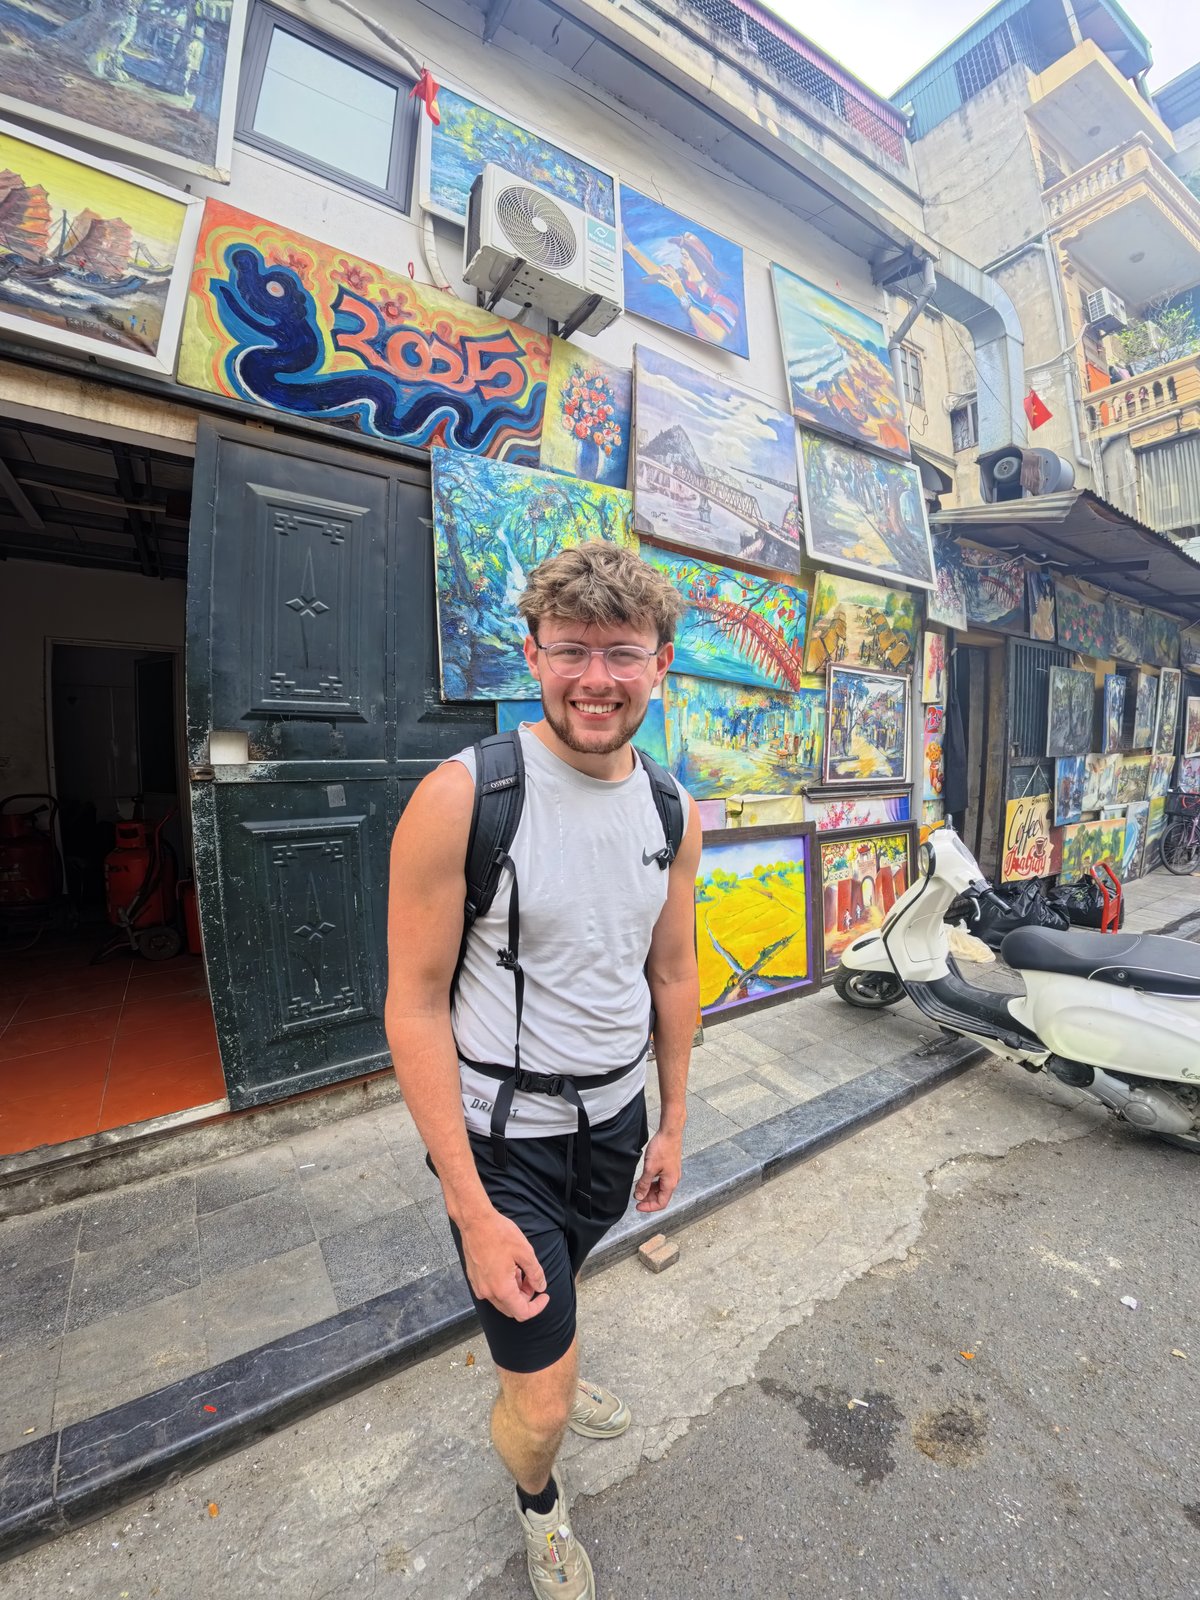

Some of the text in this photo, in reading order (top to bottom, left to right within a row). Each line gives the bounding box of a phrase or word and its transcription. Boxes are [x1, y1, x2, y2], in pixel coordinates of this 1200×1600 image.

[332, 287, 527, 404] 2025
[490, 777, 513, 789] OSPREY
[1007, 804, 1040, 856] Coffee
